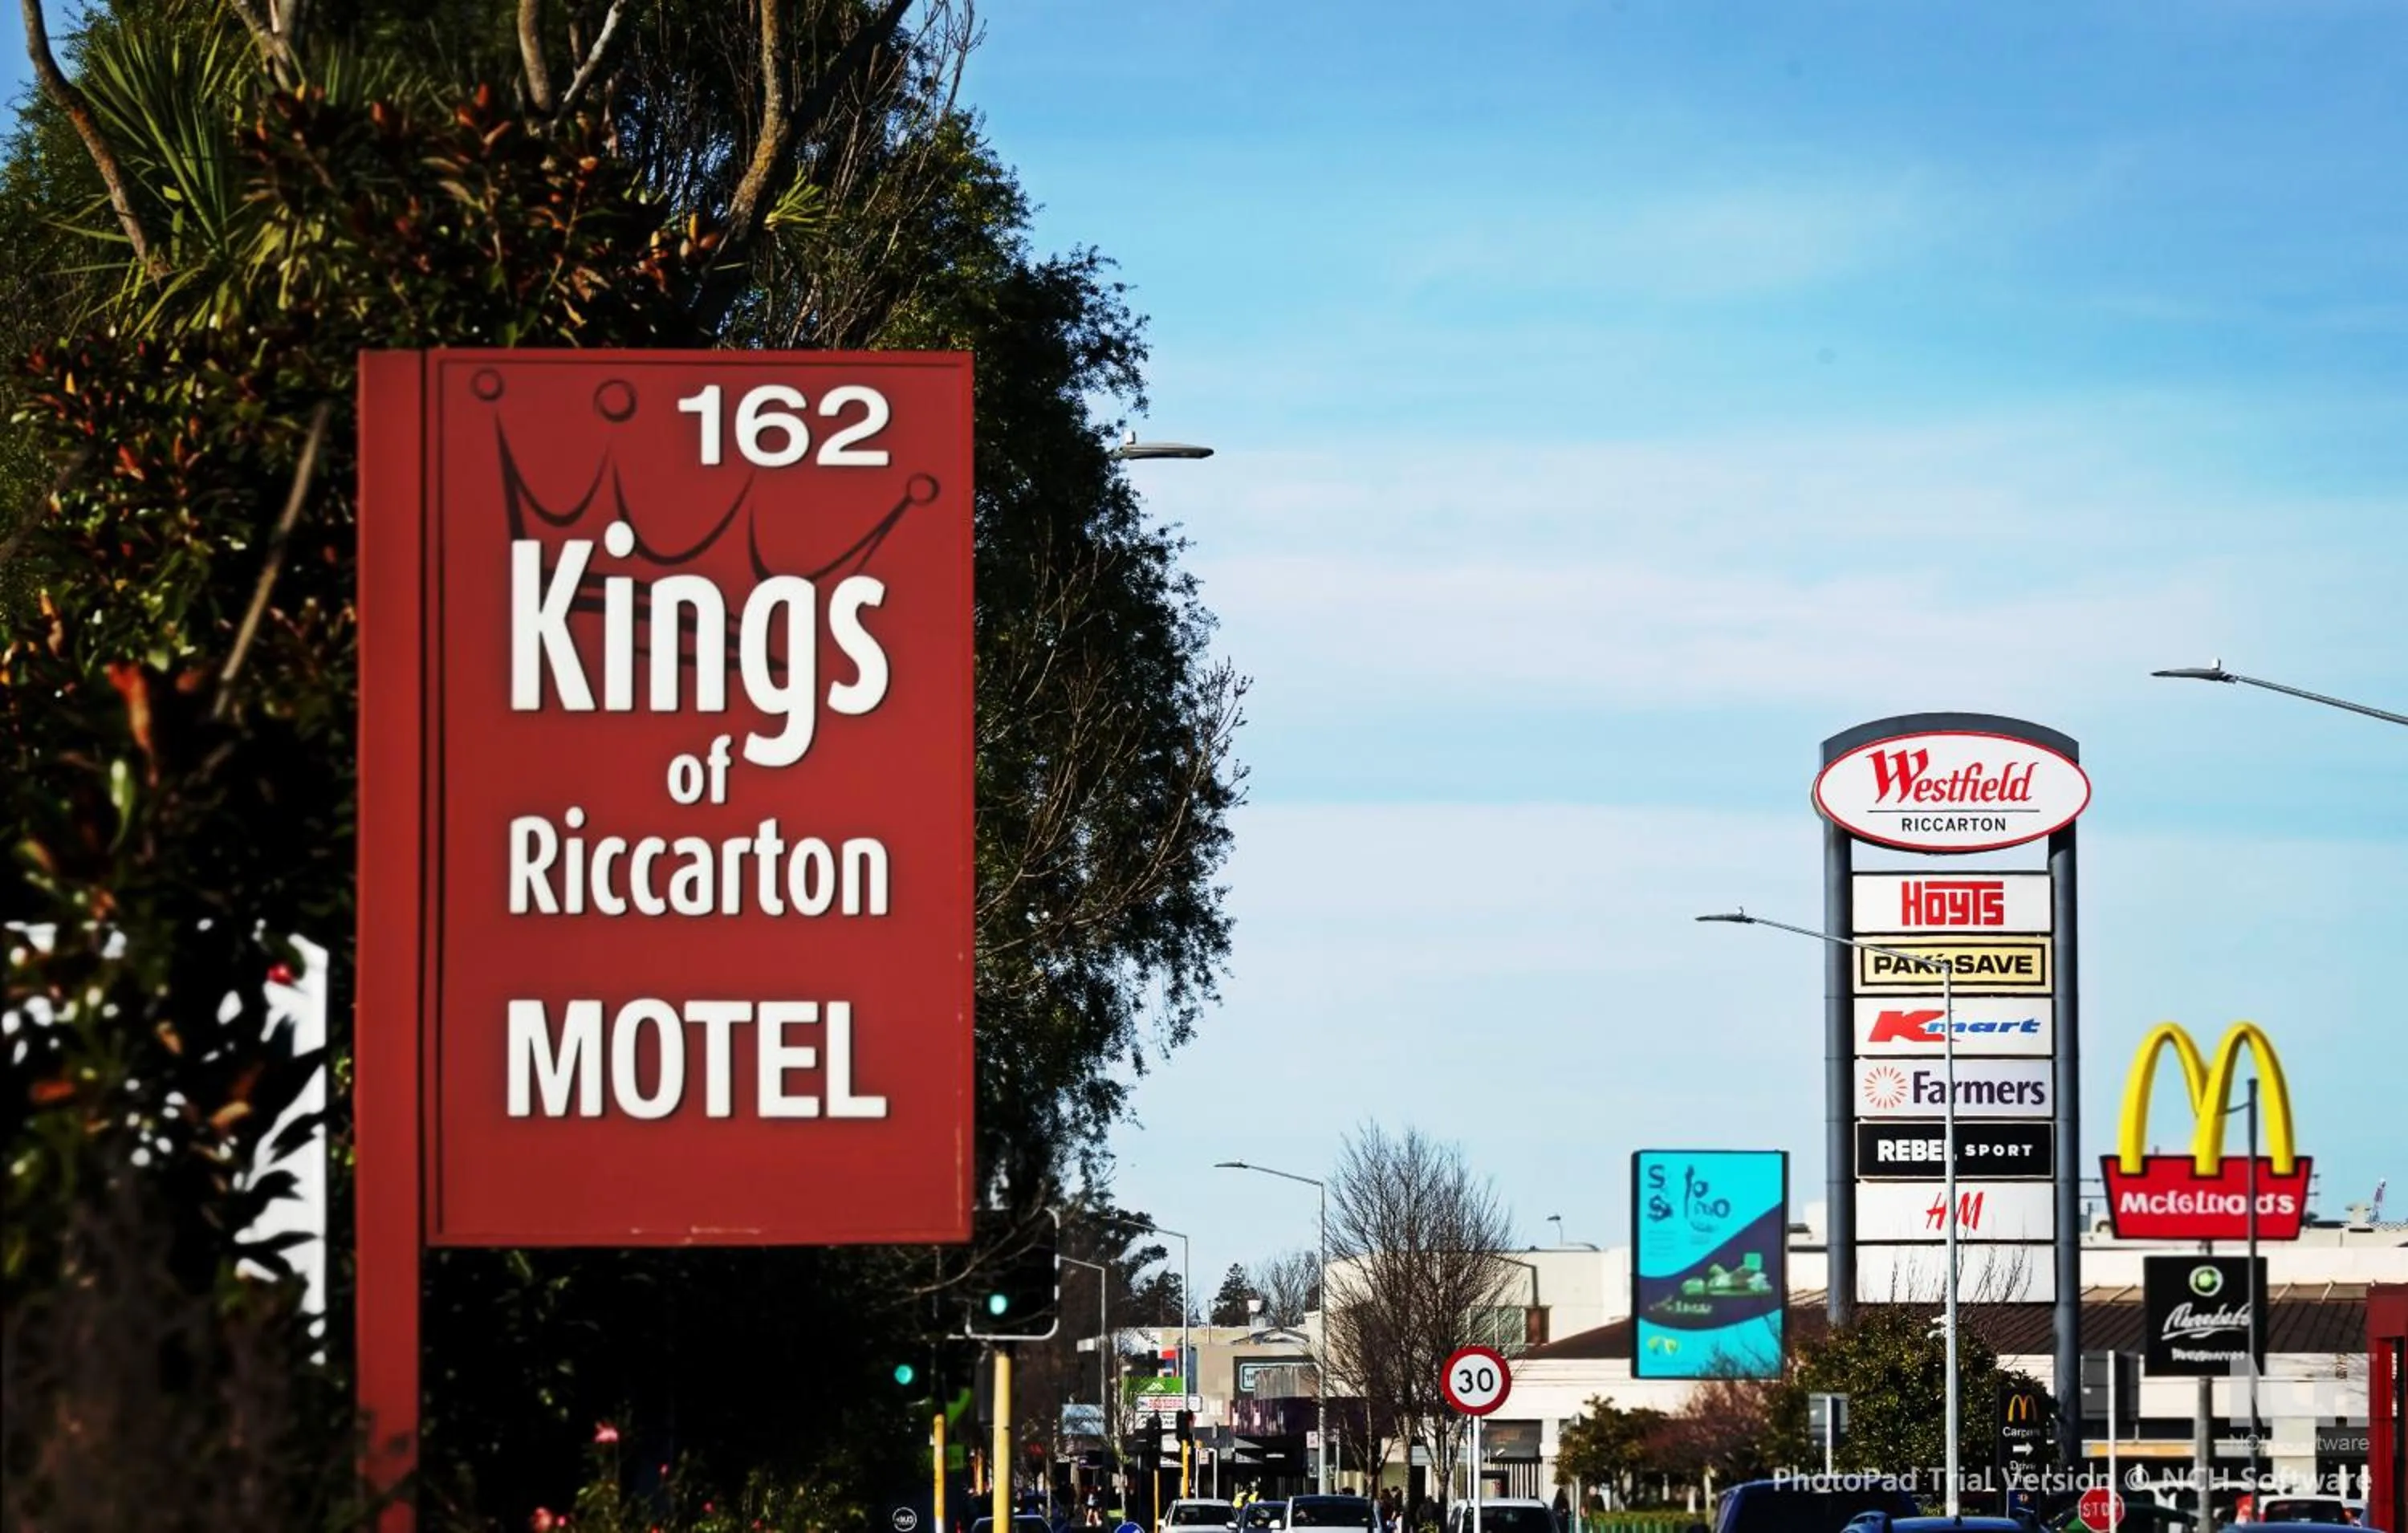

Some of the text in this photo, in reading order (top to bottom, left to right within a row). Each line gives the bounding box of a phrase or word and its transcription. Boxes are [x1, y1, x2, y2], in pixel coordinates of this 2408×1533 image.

[678, 384, 892, 466] 162
[510, 520, 892, 767] Kings
[667, 734, 734, 804] of
[1865, 747, 2040, 803] Westfield
[1902, 816, 2007, 832] RICCARTON
[508, 806, 890, 917] Riccarton
[1868, 1009, 2041, 1043] Kmart
[507, 998, 888, 1120] MOTEL
[1913, 1071, 2046, 1105] Farmers
[1964, 1144, 2033, 1157] SPORT
[1926, 1192, 1984, 1231] HM
[1458, 1368, 1495, 1394] 30
